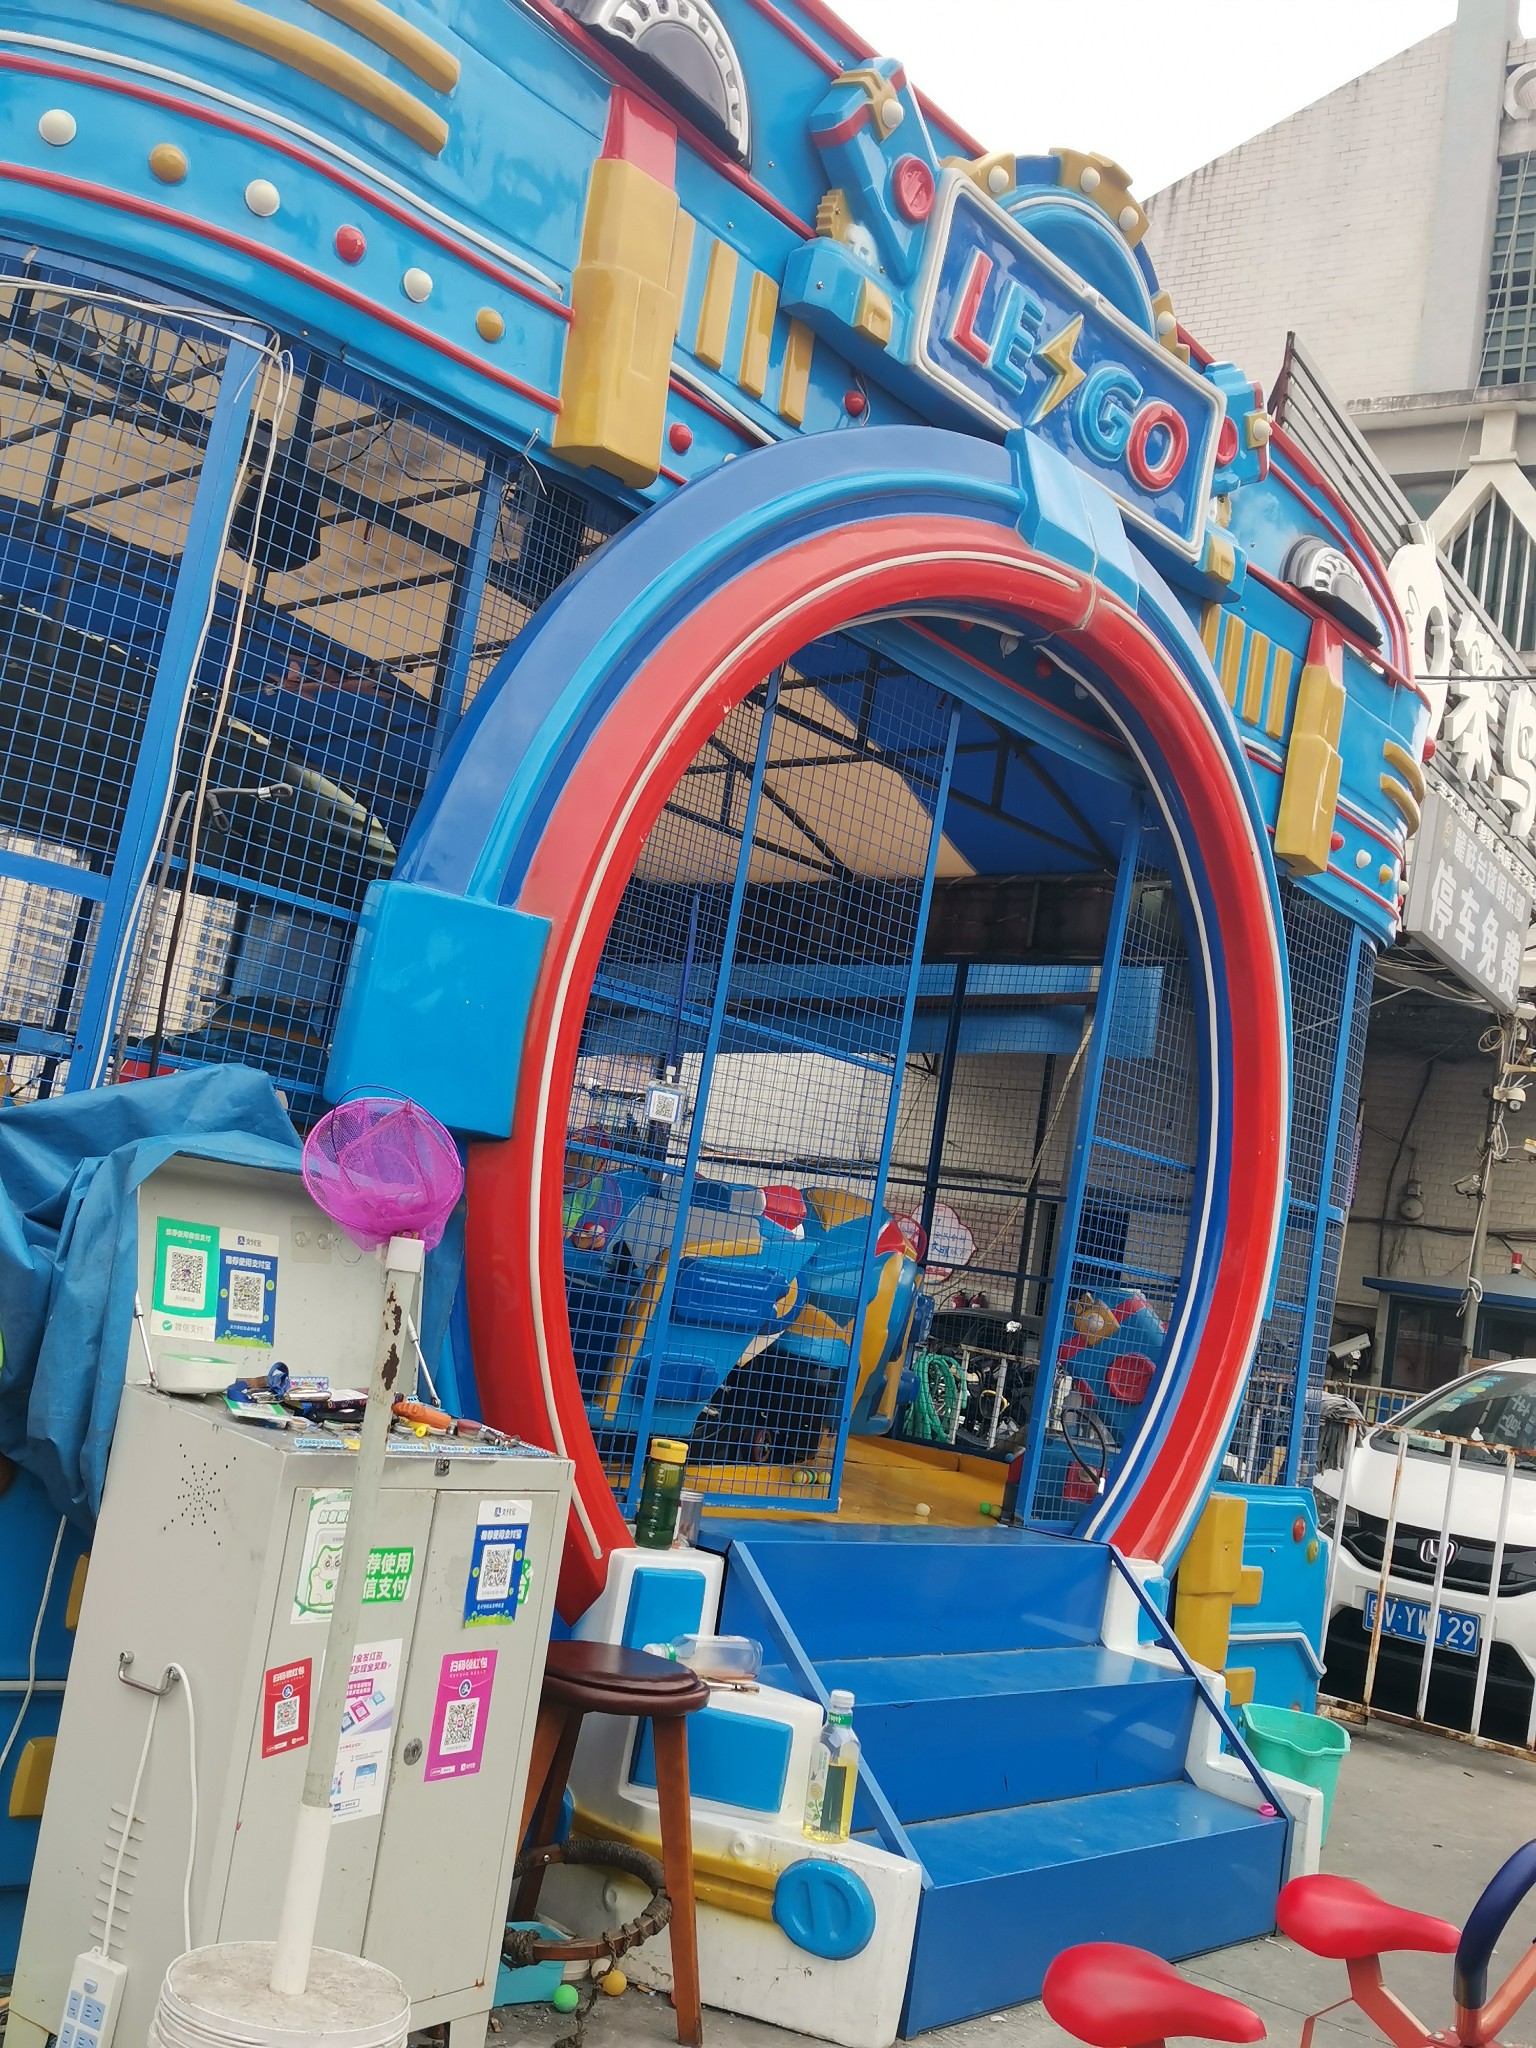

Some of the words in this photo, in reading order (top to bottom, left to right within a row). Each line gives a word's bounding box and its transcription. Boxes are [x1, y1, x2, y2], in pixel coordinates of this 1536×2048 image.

[949, 248, 1046, 395] LE
[1077, 366, 1189, 491] GO
[1429, 858, 1520, 1003] 停车免费
